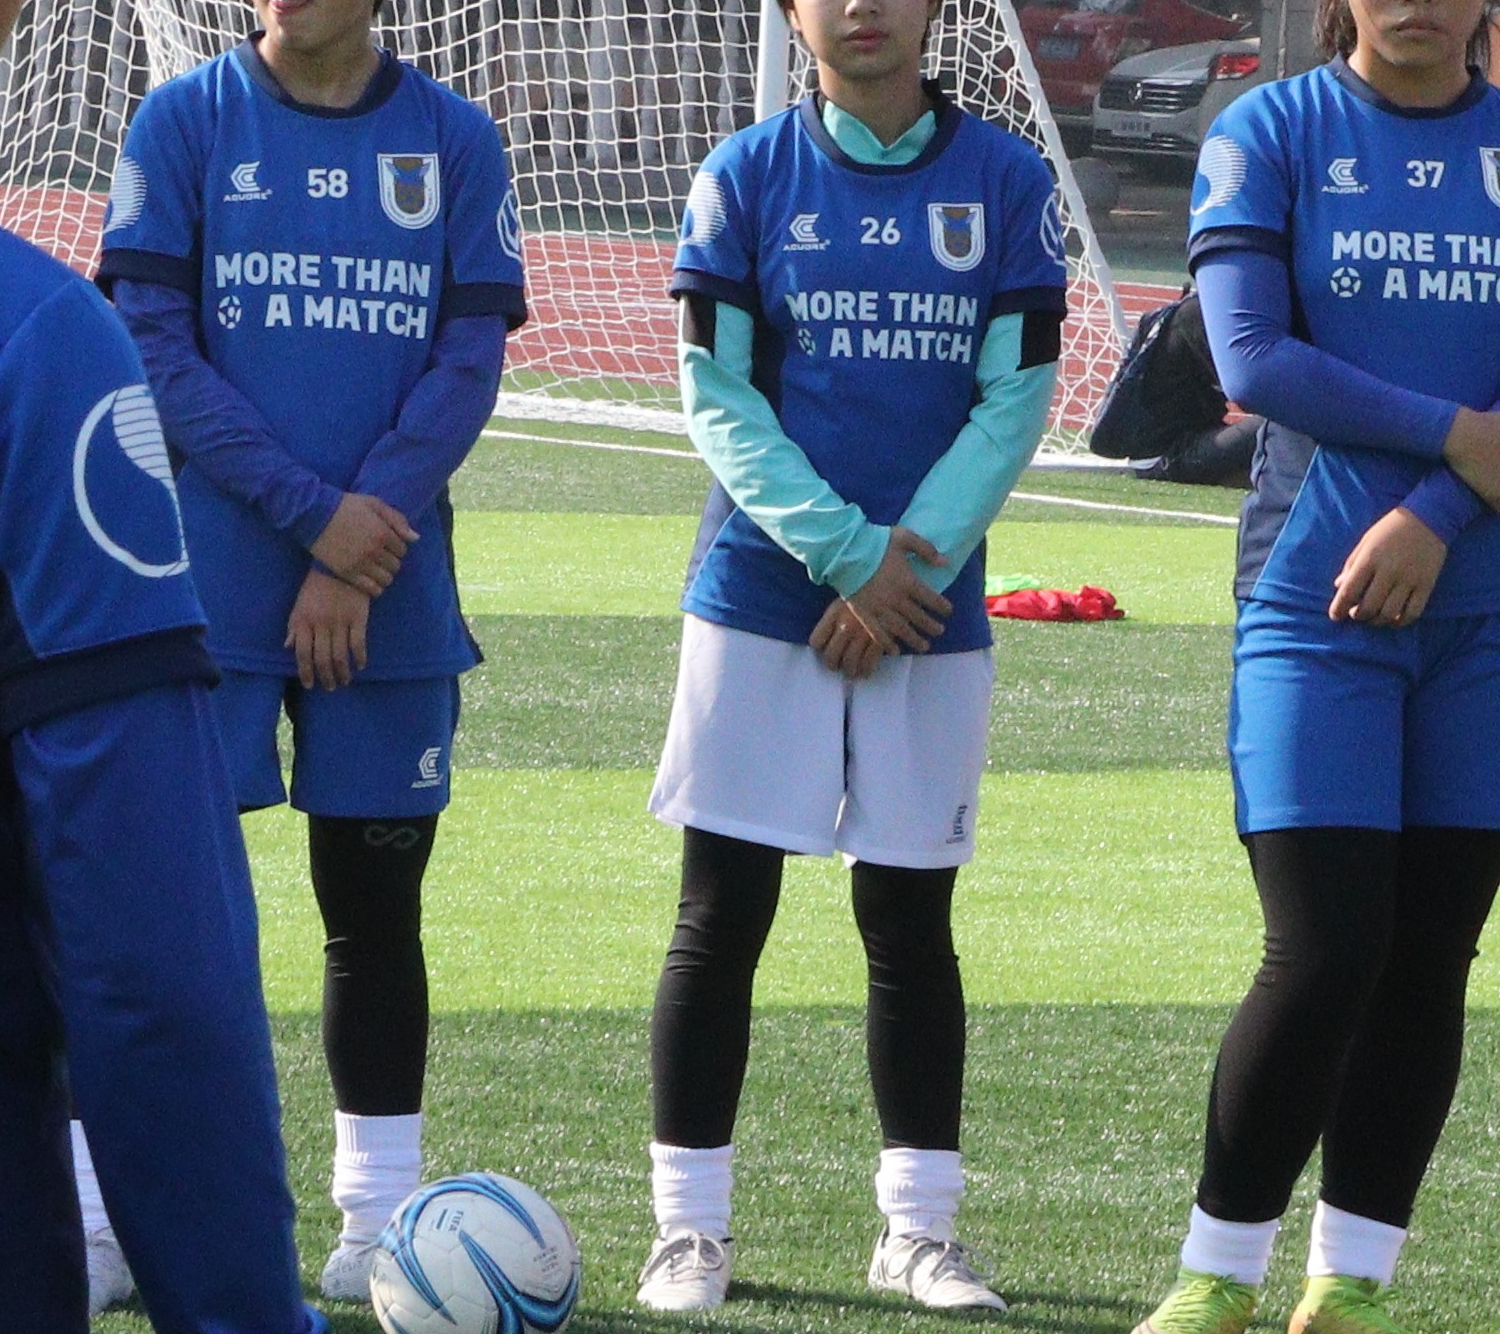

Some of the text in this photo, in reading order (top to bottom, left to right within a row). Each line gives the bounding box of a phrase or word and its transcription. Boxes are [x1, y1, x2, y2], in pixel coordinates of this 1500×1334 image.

[307, 168, 349, 199] 58
[1406, 160, 1445, 189] 37
[860, 216, 901, 245] 26
[1332, 230, 1436, 263] MORE
[214, 251, 431, 298] MORE THAN
[1382, 267, 1408, 300] A
[264, 293, 428, 339] A MATCH
[784, 290, 978, 327] MORE THAN
[829, 327, 972, 364] A MATCH
